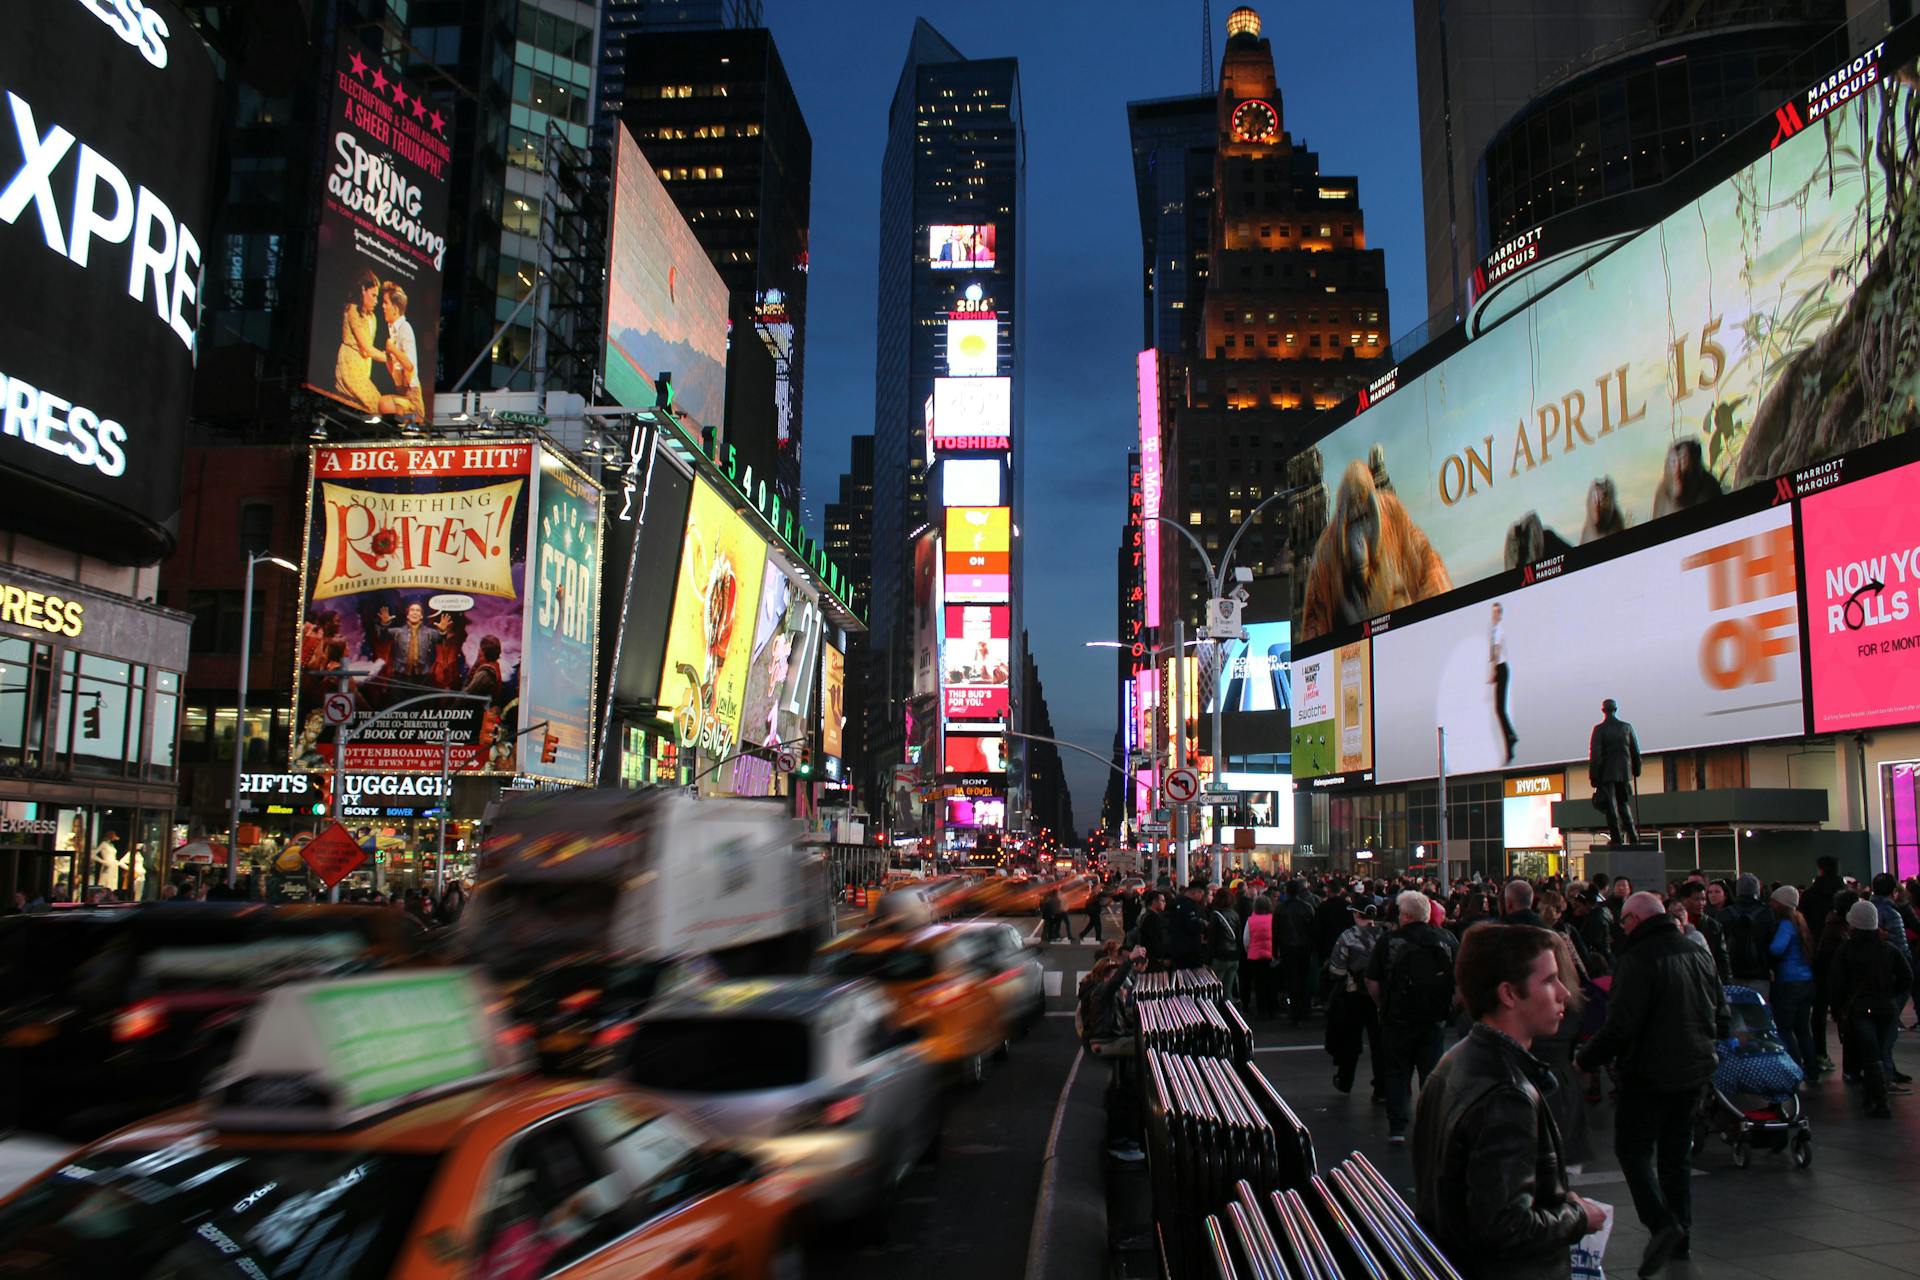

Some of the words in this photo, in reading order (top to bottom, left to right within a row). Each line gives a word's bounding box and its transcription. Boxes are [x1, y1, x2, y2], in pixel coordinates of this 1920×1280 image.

[1808, 42, 1884, 104] MARRIOTT
[1809, 66, 1876, 120] MARQUIS
[344, 97, 353, 121] A
[355, 104, 391, 146] SHEER
[335, 131, 423, 217] SPRING
[328, 173, 447, 272] awakening
[1488, 226, 1543, 268] MARRIOTT
[1488, 246, 1536, 283] MARQUIS
[948, 311, 997, 320] TOSHIBA
[957, 299, 988, 312] 2016
[1370, 366, 1398, 392] MARRIOTT
[1370, 380, 1395, 403] MARQUIS
[1437, 434, 1495, 507] ON
[1508, 361, 1648, 479] APRIL
[1670, 314, 1726, 403] 15
[934, 436, 1010, 450] TOSHIBA
[349, 450, 399, 472] BIG,
[407, 449, 455, 470] FAT
[1796, 458, 1844, 482] MARRIOTT
[1797, 472, 1839, 494] MARQUIS
[350, 492, 492, 513] SOMETHING
[703, 426, 767, 513] 1540
[771, 493, 855, 609] BROADWAY
[1131, 472, 1142, 567] ERNST
[543, 501, 592, 560] BRIGHT
[969, 556, 985, 566] ON
[1536, 555, 1564, 571] MARRIOTT
[443, 576, 462, 587] NEW
[1536, 565, 1562, 580] MARQUIS
[1825, 555, 1887, 600] NOW
[538, 542, 590, 645] STAR
[1132, 587, 1143, 600] &
[1698, 606, 1797, 691] OF
[1858, 643, 1878, 657] FOR
[1880, 641, 1890, 654] 12
[789, 601, 823, 720] 21
[948, 690, 966, 698] THIS
[968, 690, 992, 698] BUD'S
[948, 698, 964, 706] FOR
[965, 698, 984, 706] YOU.
[376, 720, 391, 728] THE
[391, 721, 438, 729] CO-DIRECTOR
[439, 721, 450, 729] OF
[410, 711, 420, 719] OF
[420, 710, 474, 719] ALADDIN
[364, 729, 396, 740] BOOK
[399, 729, 416, 739] OF
[378, 760, 405, 768] BTWN
[239, 773, 308, 793] GIFTS
[330, 776, 452, 796] UGGAGE
[1516, 777, 1551, 793] INVICTA
[343, 807, 380, 816] SONY
[386, 808, 414, 816] BOWER
[0, 817, 57, 834] EXPRESS
